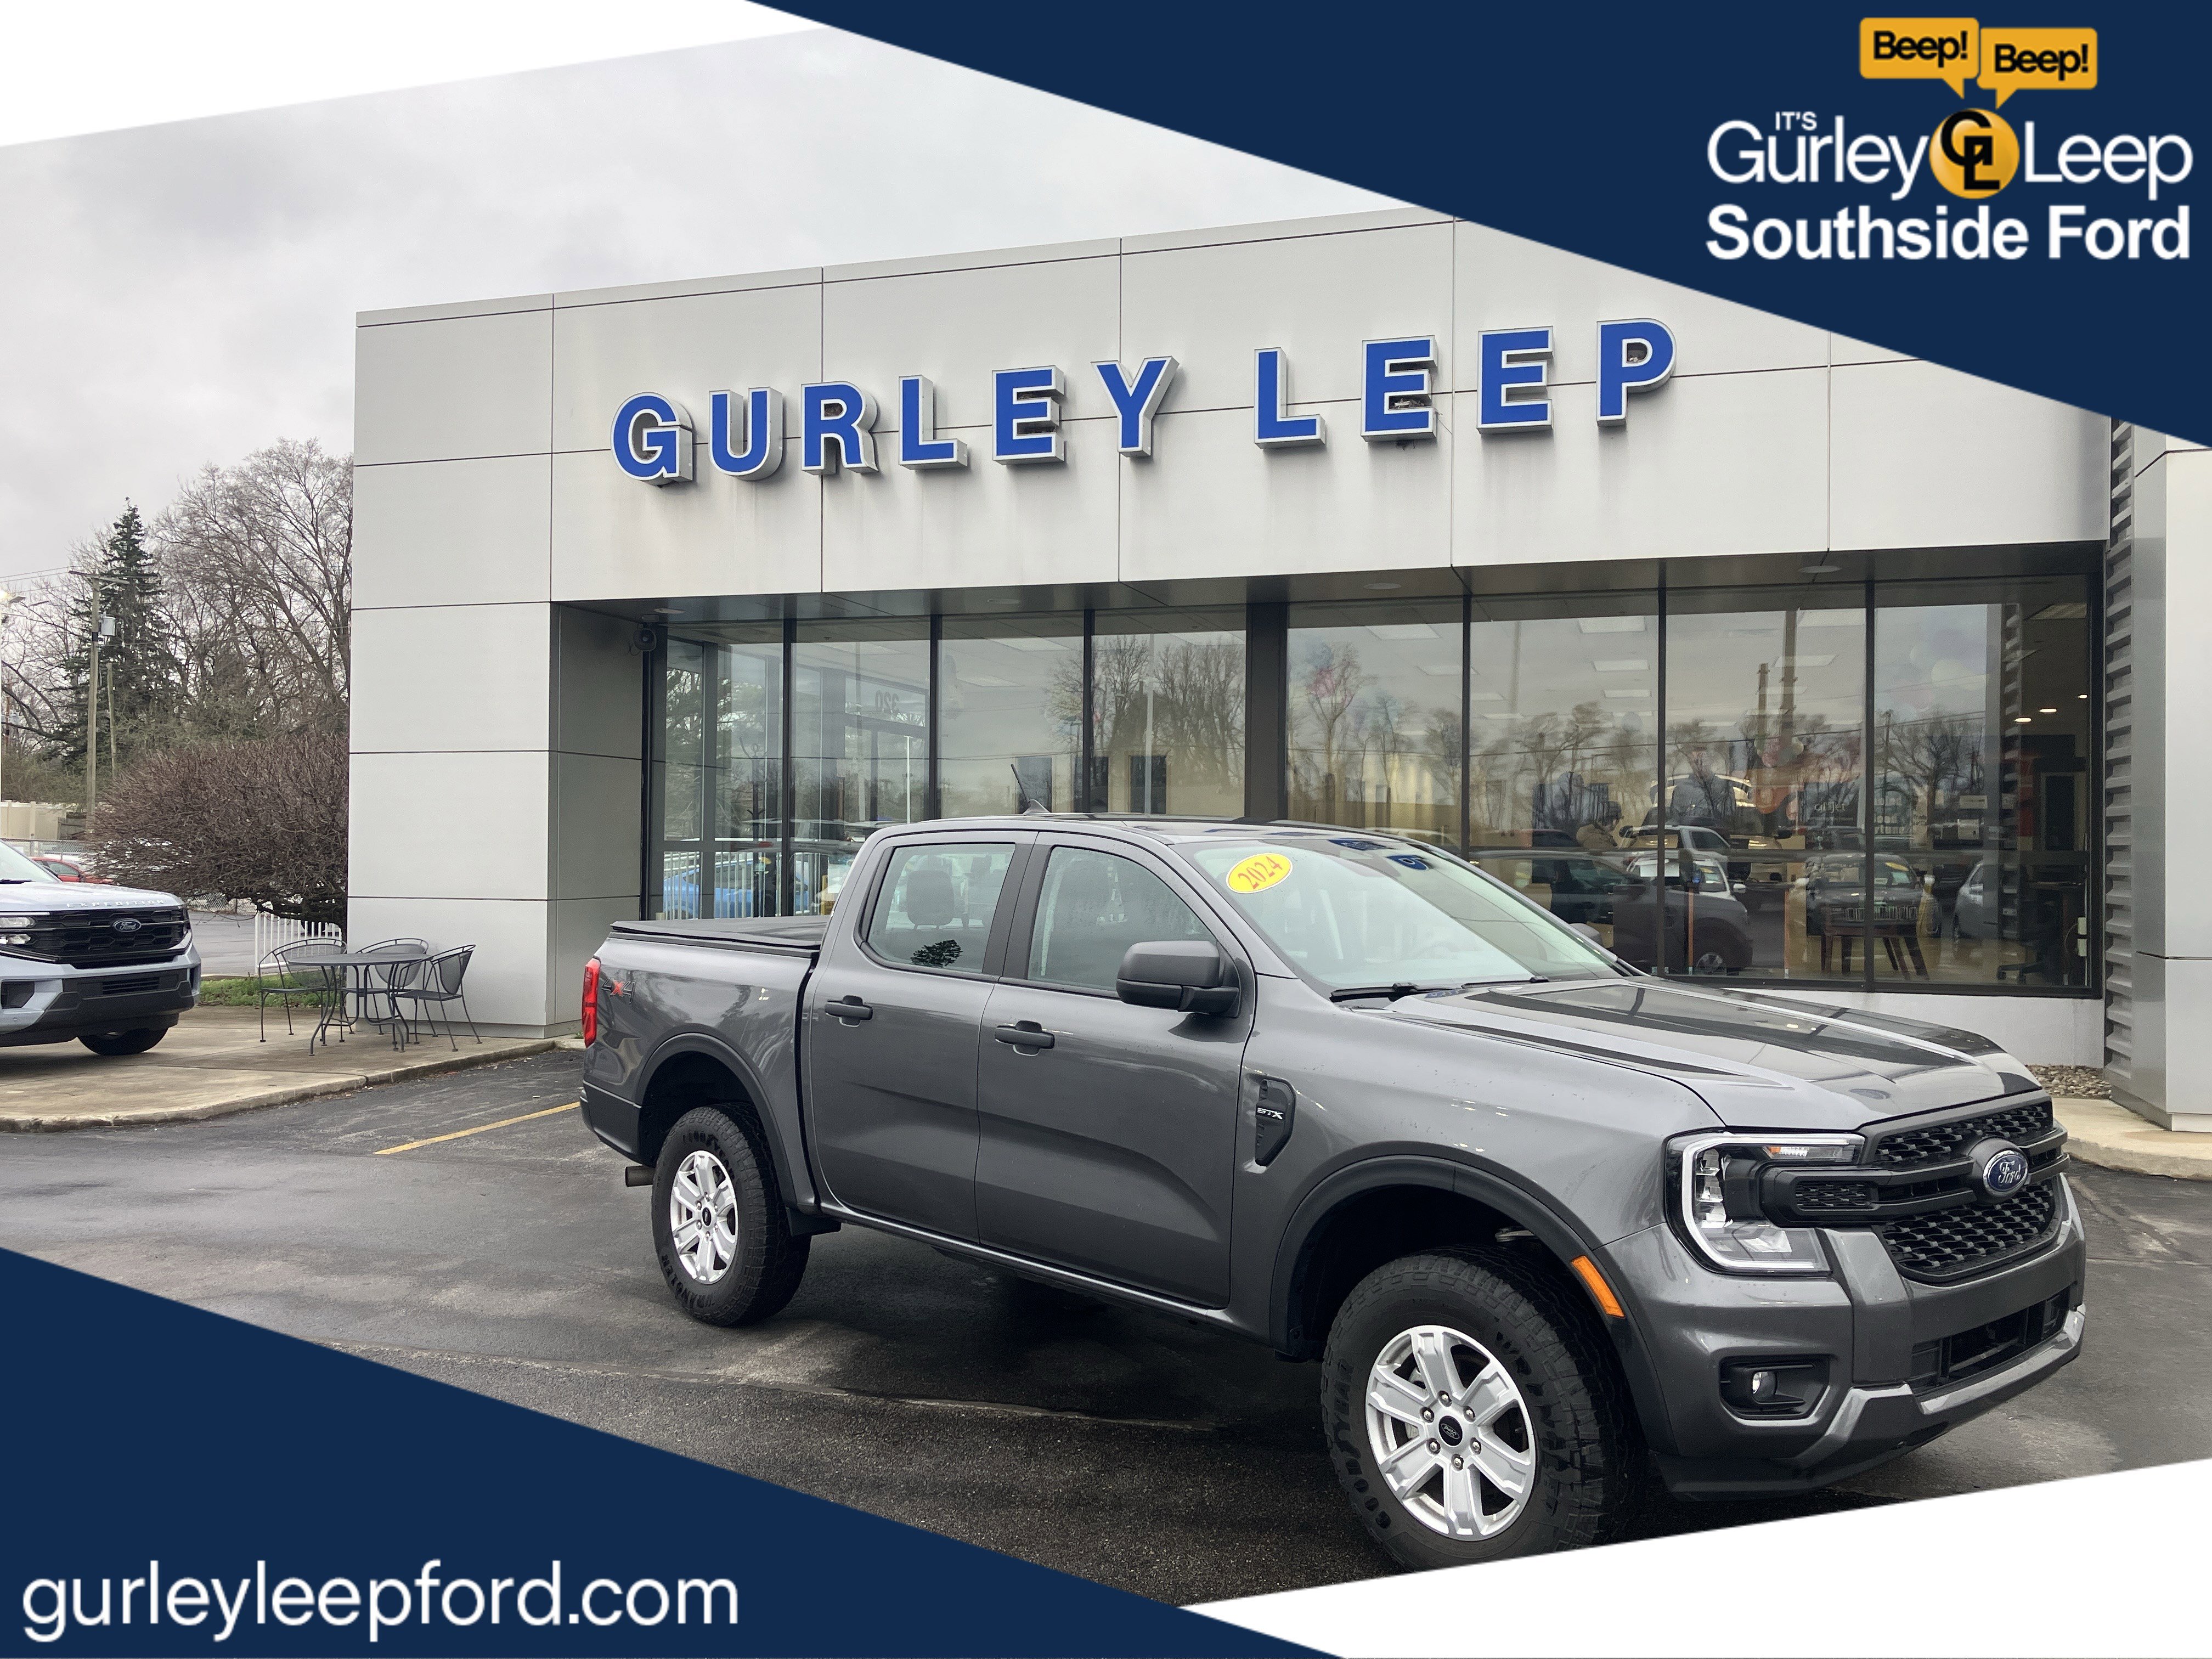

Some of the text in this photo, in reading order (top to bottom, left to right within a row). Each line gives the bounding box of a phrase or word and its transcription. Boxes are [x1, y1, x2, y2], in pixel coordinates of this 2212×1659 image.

[610, 318, 1677, 487] GURLEY LEEP
[1238, 855, 1283, 890] 2024
[66, 899, 165, 909] EXPEDITION
[119, 921, 138, 931] Ford
[1257, 1107, 1283, 1120] STX
[1997, 1159, 2022, 1185] Ford
